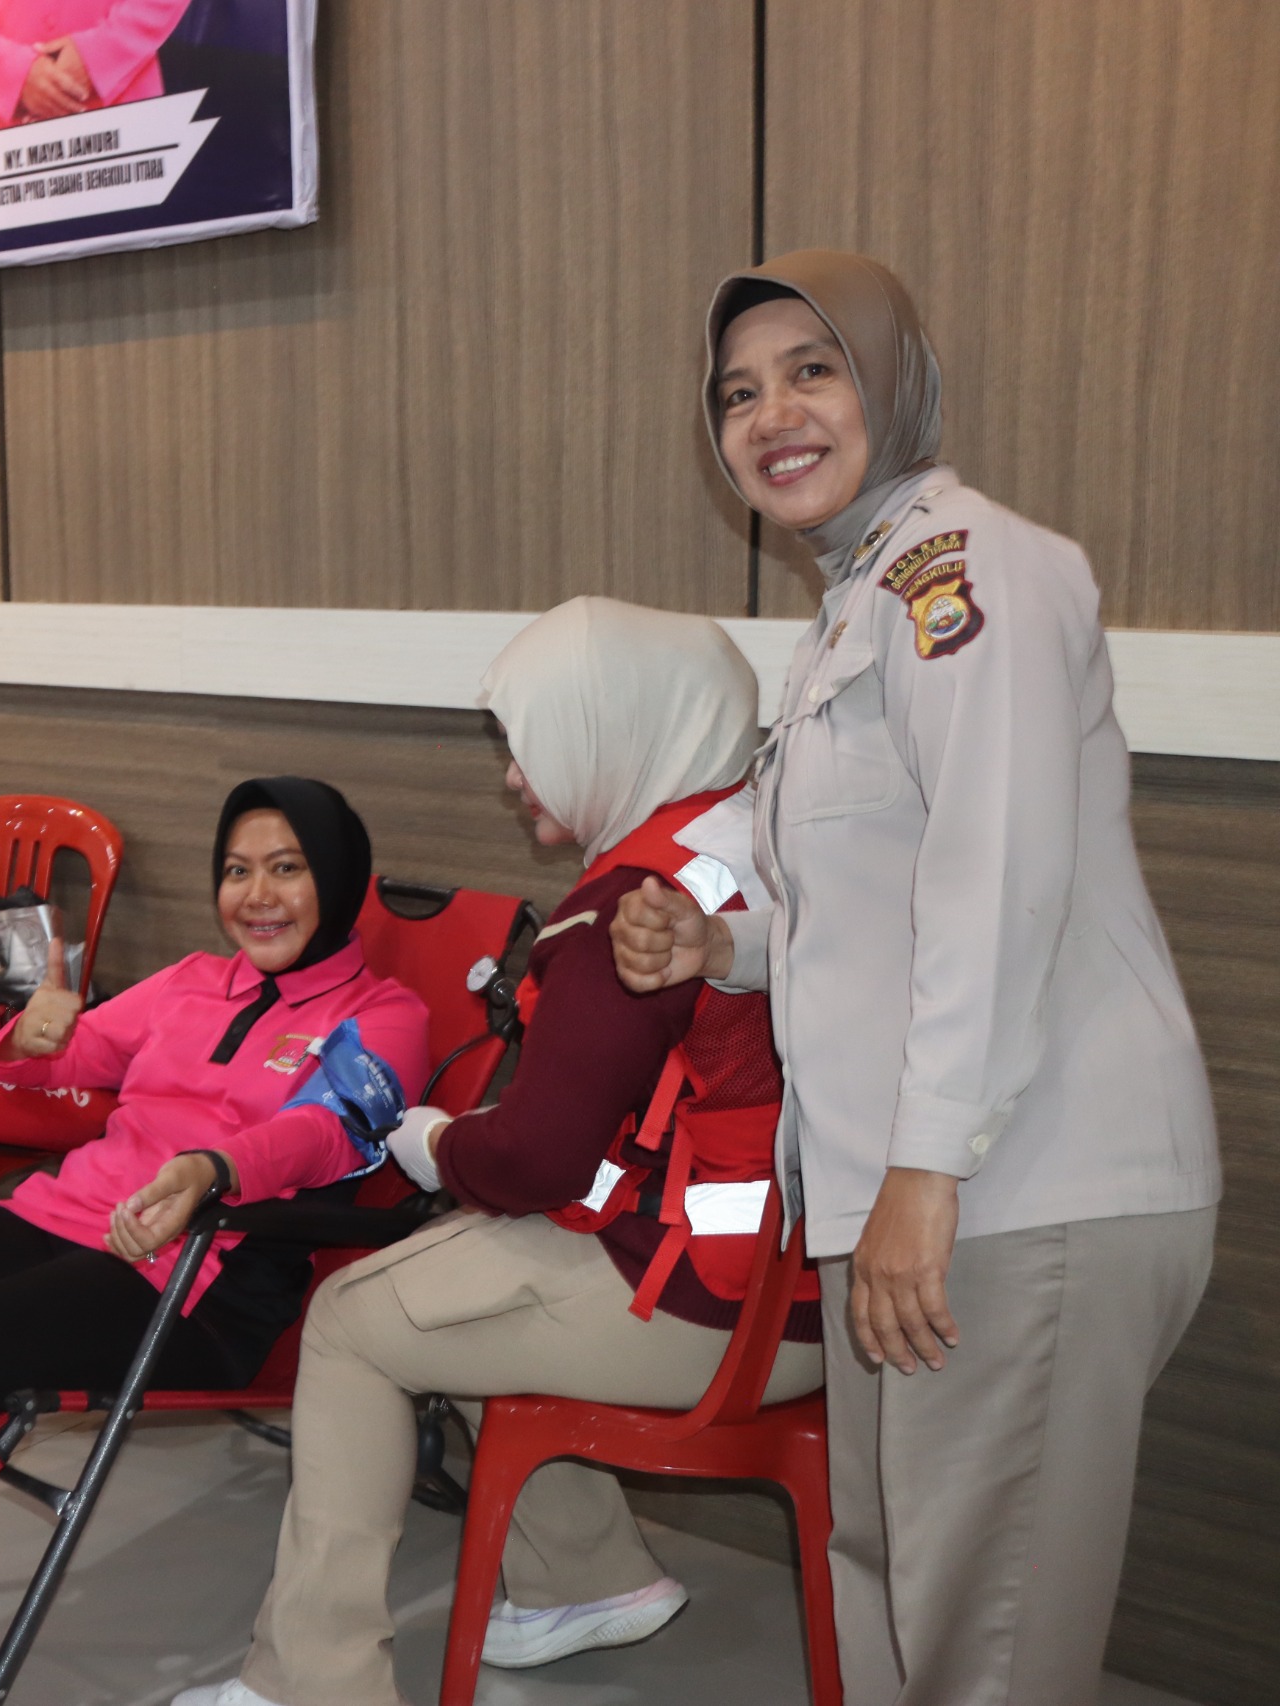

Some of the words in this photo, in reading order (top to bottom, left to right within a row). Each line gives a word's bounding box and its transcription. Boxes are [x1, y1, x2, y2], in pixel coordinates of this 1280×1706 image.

[26, 140, 65, 166] MAYA
[68, 128, 120, 158] JANURI
[85, 163, 132, 191] BENGKULU
[905, 561, 964, 600] BENGKULU
